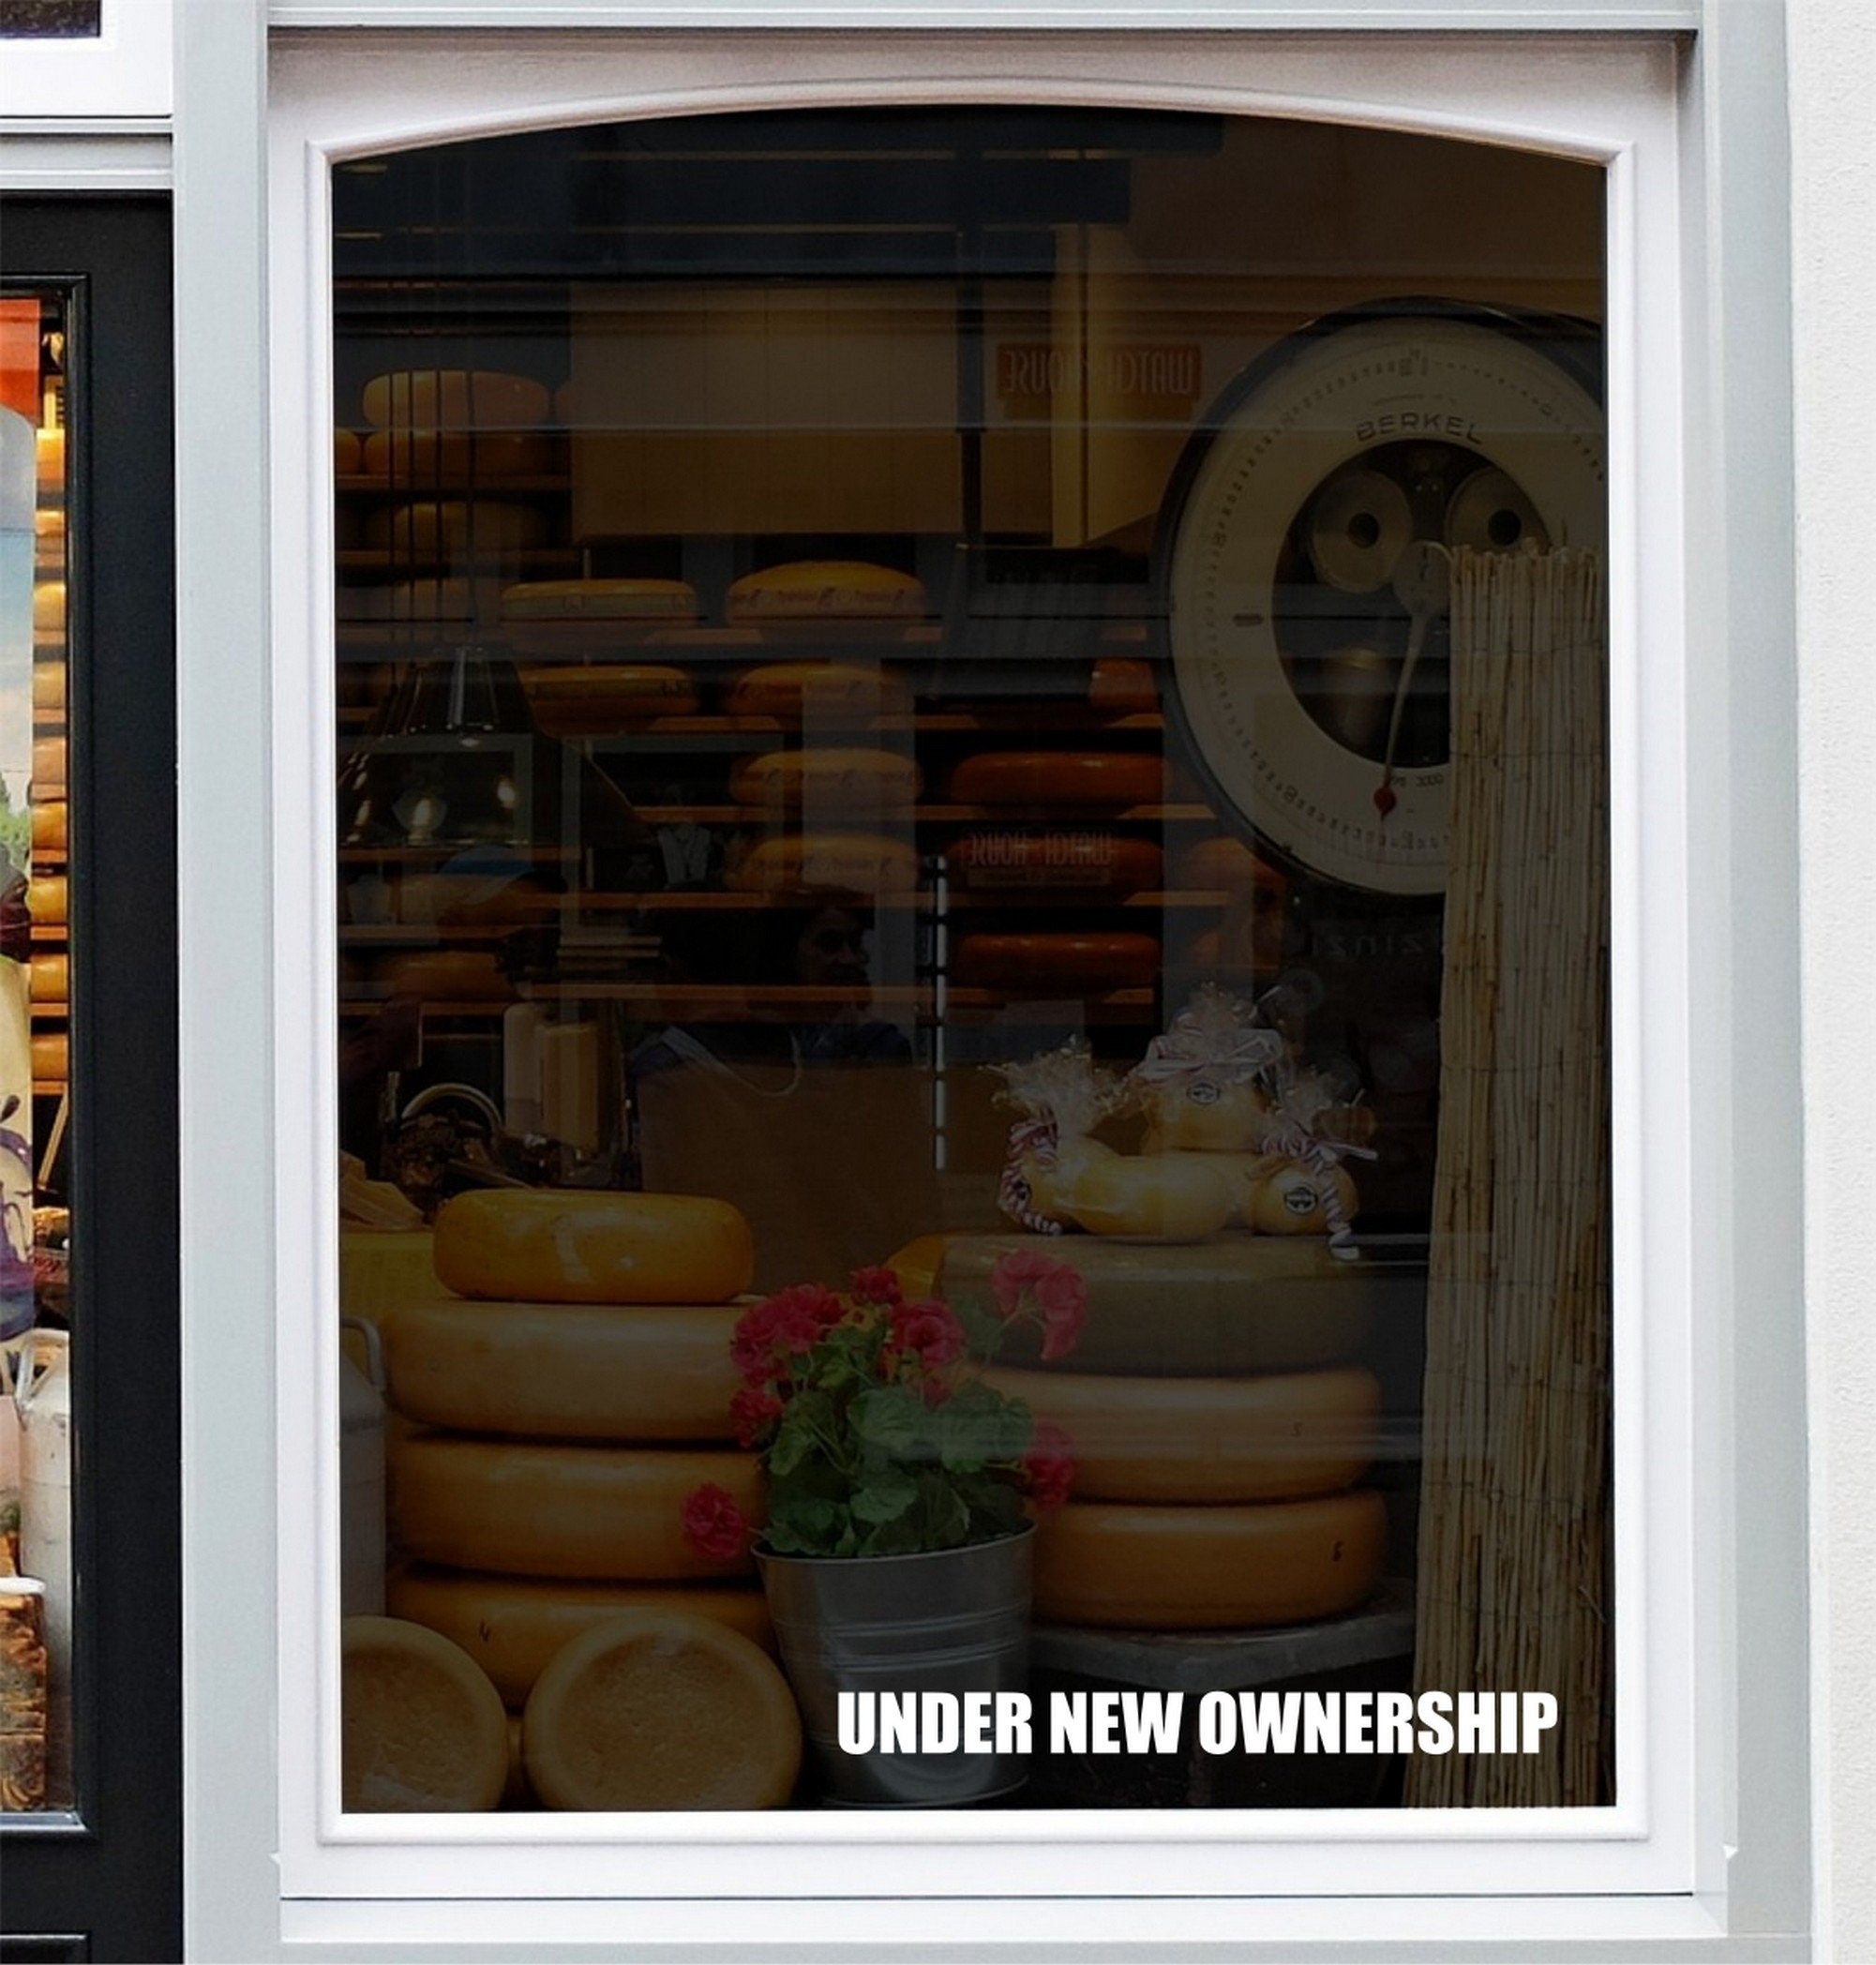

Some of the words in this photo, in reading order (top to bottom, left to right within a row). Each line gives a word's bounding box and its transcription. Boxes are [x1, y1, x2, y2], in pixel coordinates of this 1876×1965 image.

[1356, 412, 1483, 445] BERKEL
[838, 1690, 1032, 1755] UNDER
[1050, 1690, 1184, 1755] NEW
[1199, 1690, 1558, 1755] OWNERSHIP
